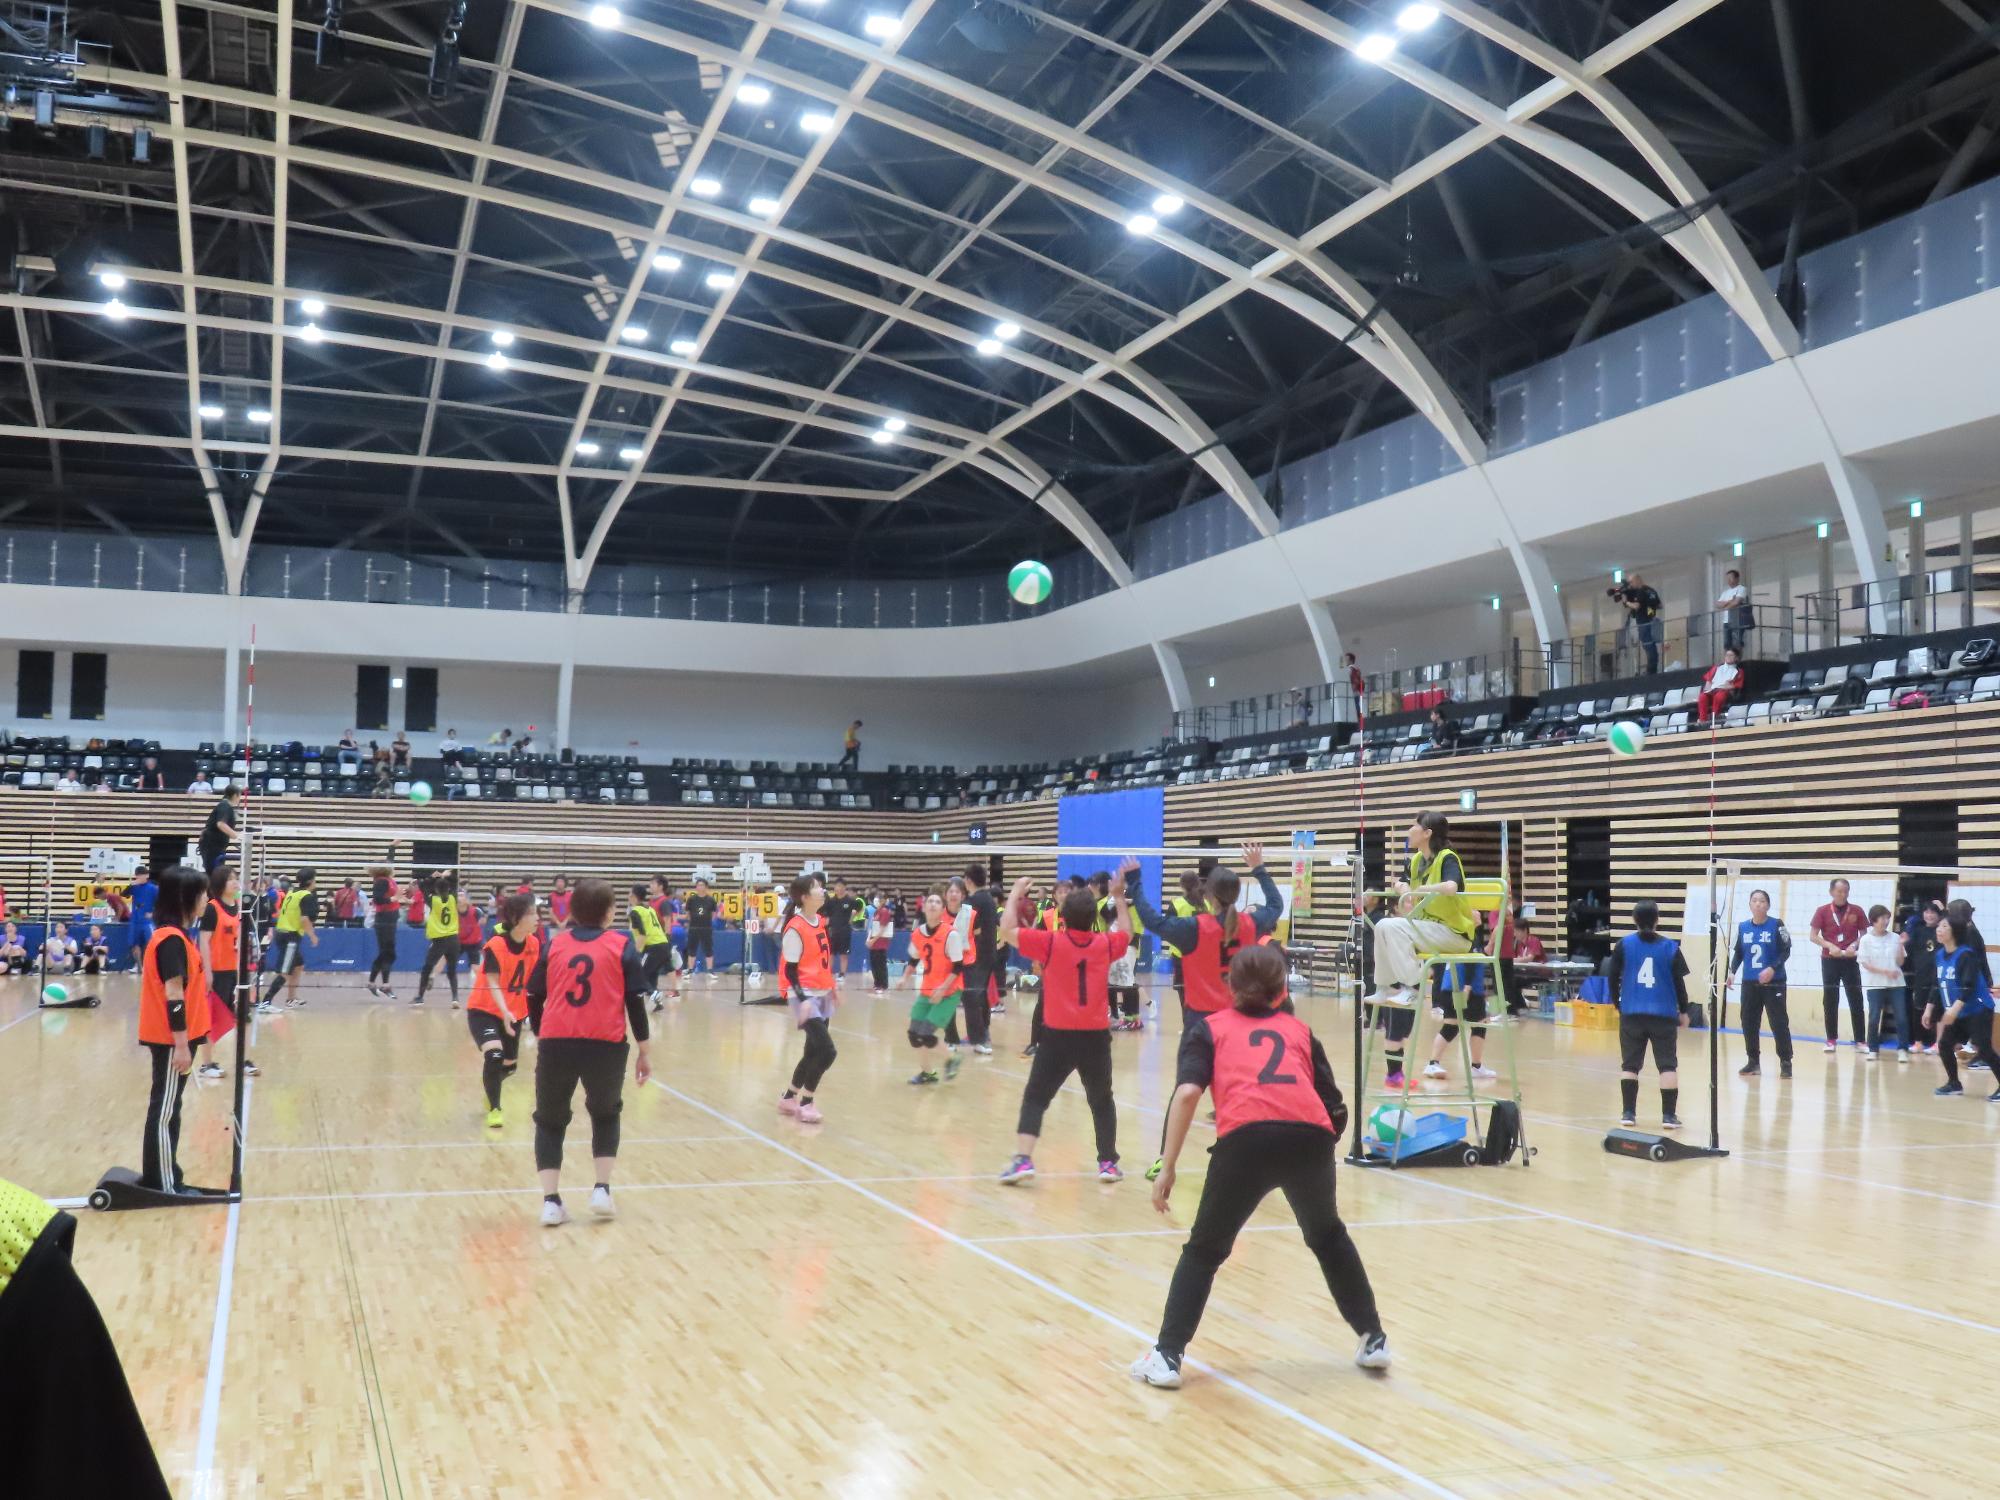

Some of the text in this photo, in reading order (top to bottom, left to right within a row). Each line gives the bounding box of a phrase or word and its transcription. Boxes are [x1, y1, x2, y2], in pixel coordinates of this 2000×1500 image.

[79, 885, 88, 901] 0
[728, 895, 739, 914] 5
[763, 895, 774, 914] 5
[440, 906, 452, 926] 6
[697, 907, 704, 915] 2
[817, 932, 830, 970] 5
[923, 943, 933, 975] 3
[1750, 944, 1762, 969] 2
[1926, 940, 1935, 952] 3
[507, 960, 525, 996] 4
[565, 953, 594, 1008] 3
[1076, 959, 1087, 1007] 1
[1637, 957, 1655, 988] 4
[1940, 980, 1952, 1009] 1
[1248, 1029, 1297, 1085] 2
